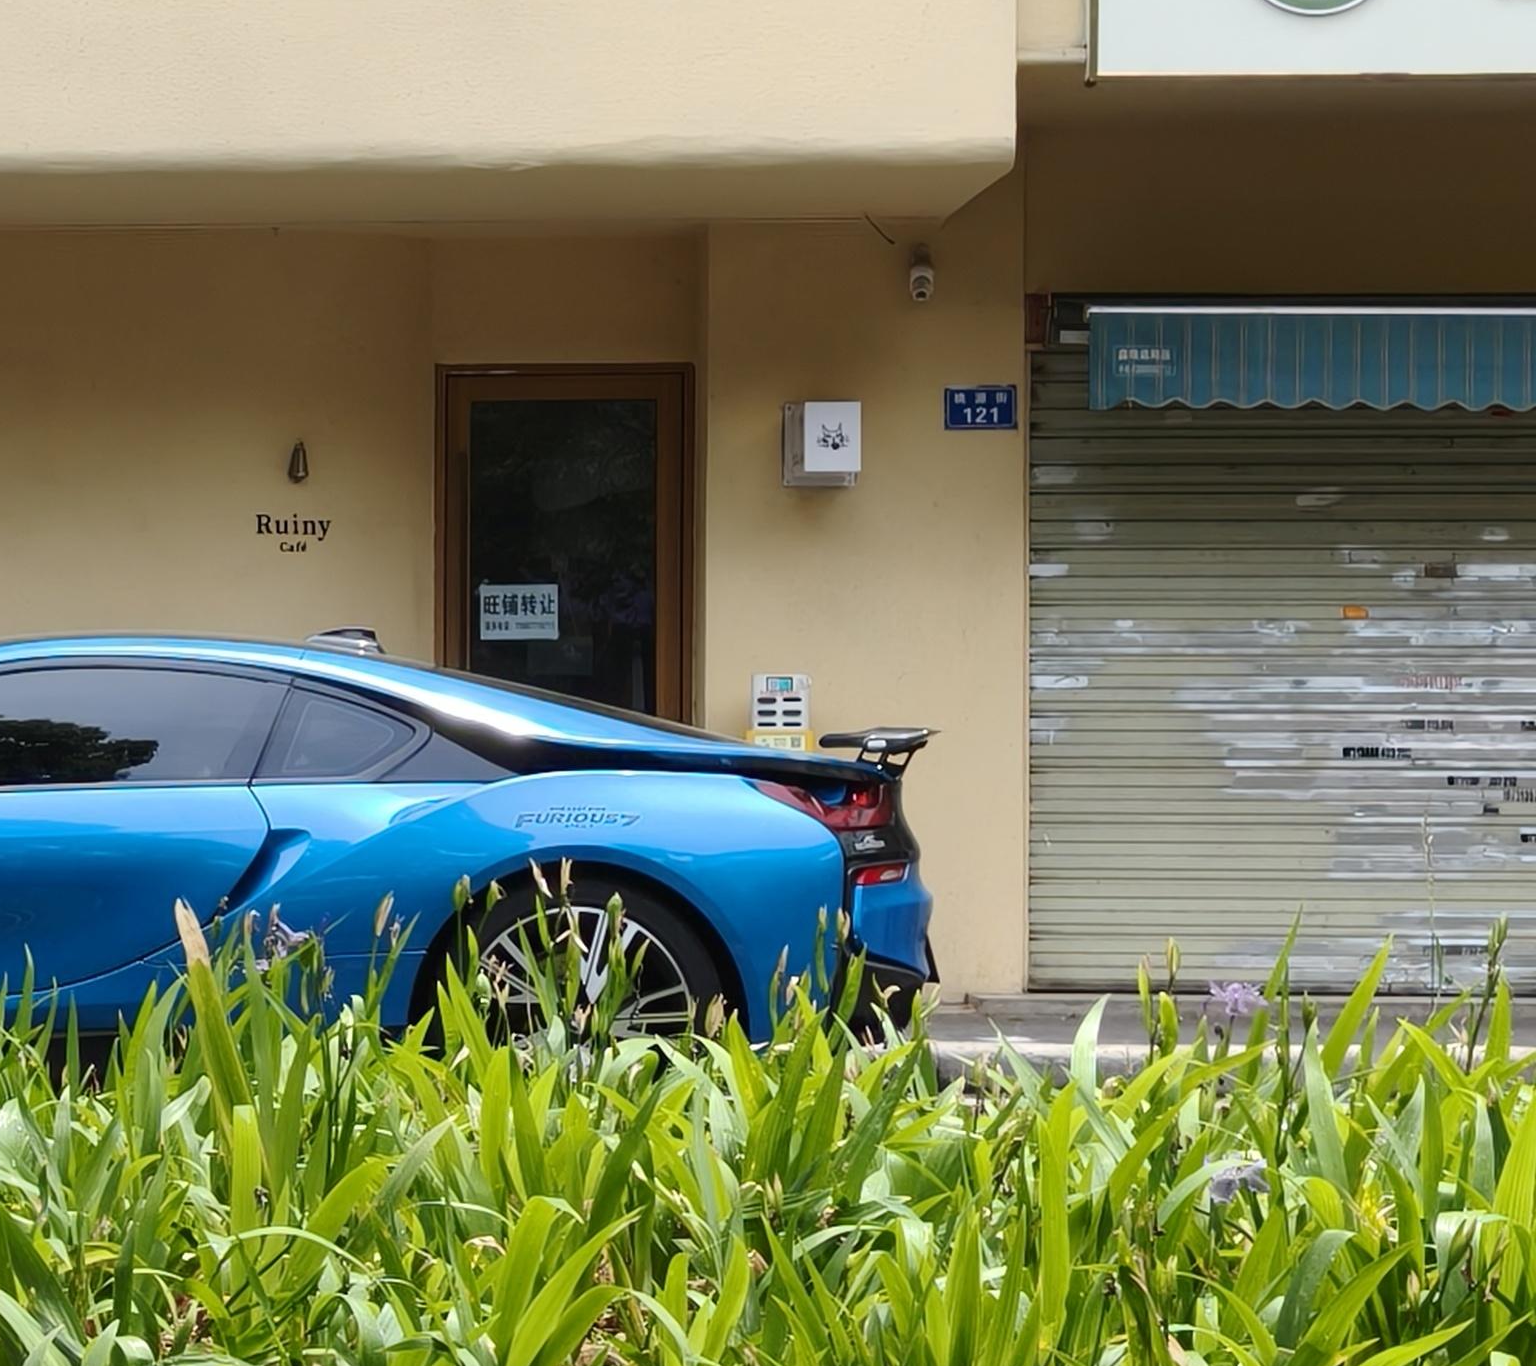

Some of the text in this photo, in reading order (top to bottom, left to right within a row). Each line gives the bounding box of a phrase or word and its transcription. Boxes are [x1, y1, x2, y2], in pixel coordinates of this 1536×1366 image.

[963, 406, 999, 423] 121
[256, 513, 331, 541] Ruiny
[484, 593, 555, 616] 旺铺转让
